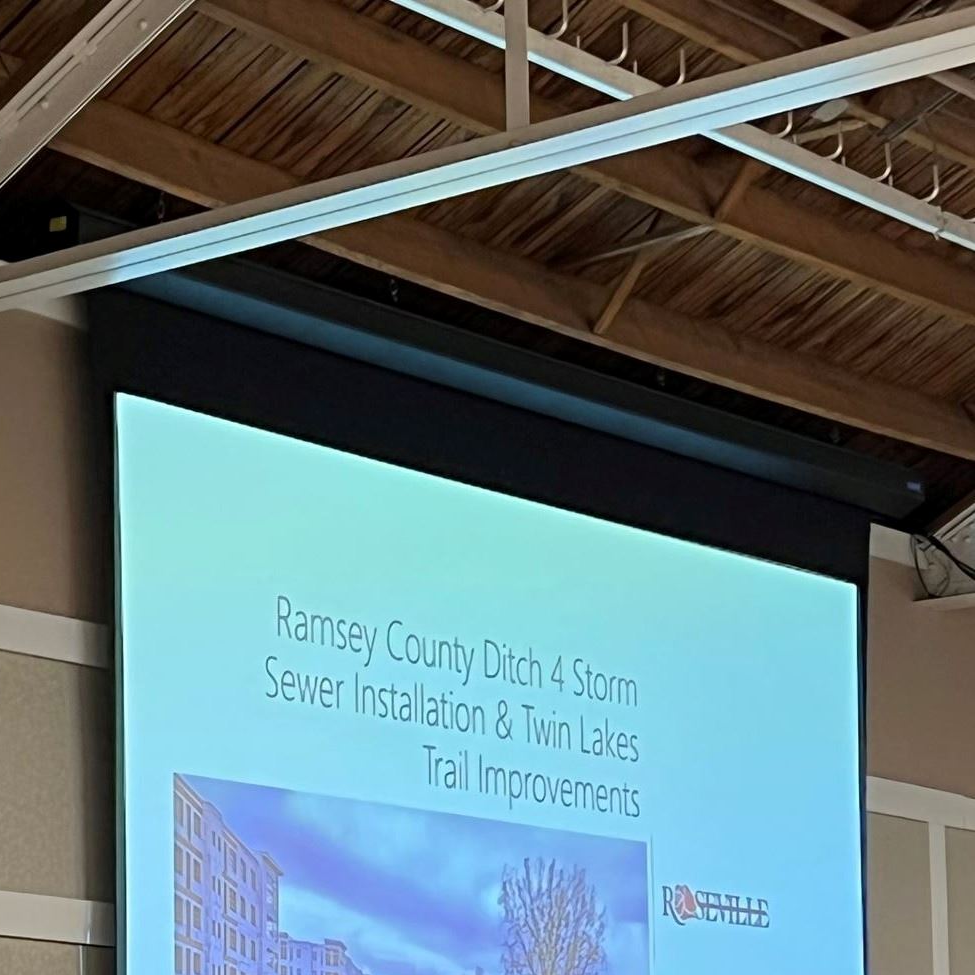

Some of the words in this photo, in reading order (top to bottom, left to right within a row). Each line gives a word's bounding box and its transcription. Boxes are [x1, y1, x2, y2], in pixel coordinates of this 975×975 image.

[277, 595, 377, 667] Ramsey
[386, 620, 475, 686] County
[484, 639, 542, 688] Ditch
[550, 655, 565, 692] 4
[573, 658, 638, 707] Storm
[265, 655, 345, 709] Sewer
[355, 672, 486, 736] Installation
[495, 700, 513, 740] &
[521, 704, 572, 750] Twin
[580, 714, 640, 762] Lakes
[422, 745, 469, 791] Trail
[478, 753, 641, 818] Improvements
